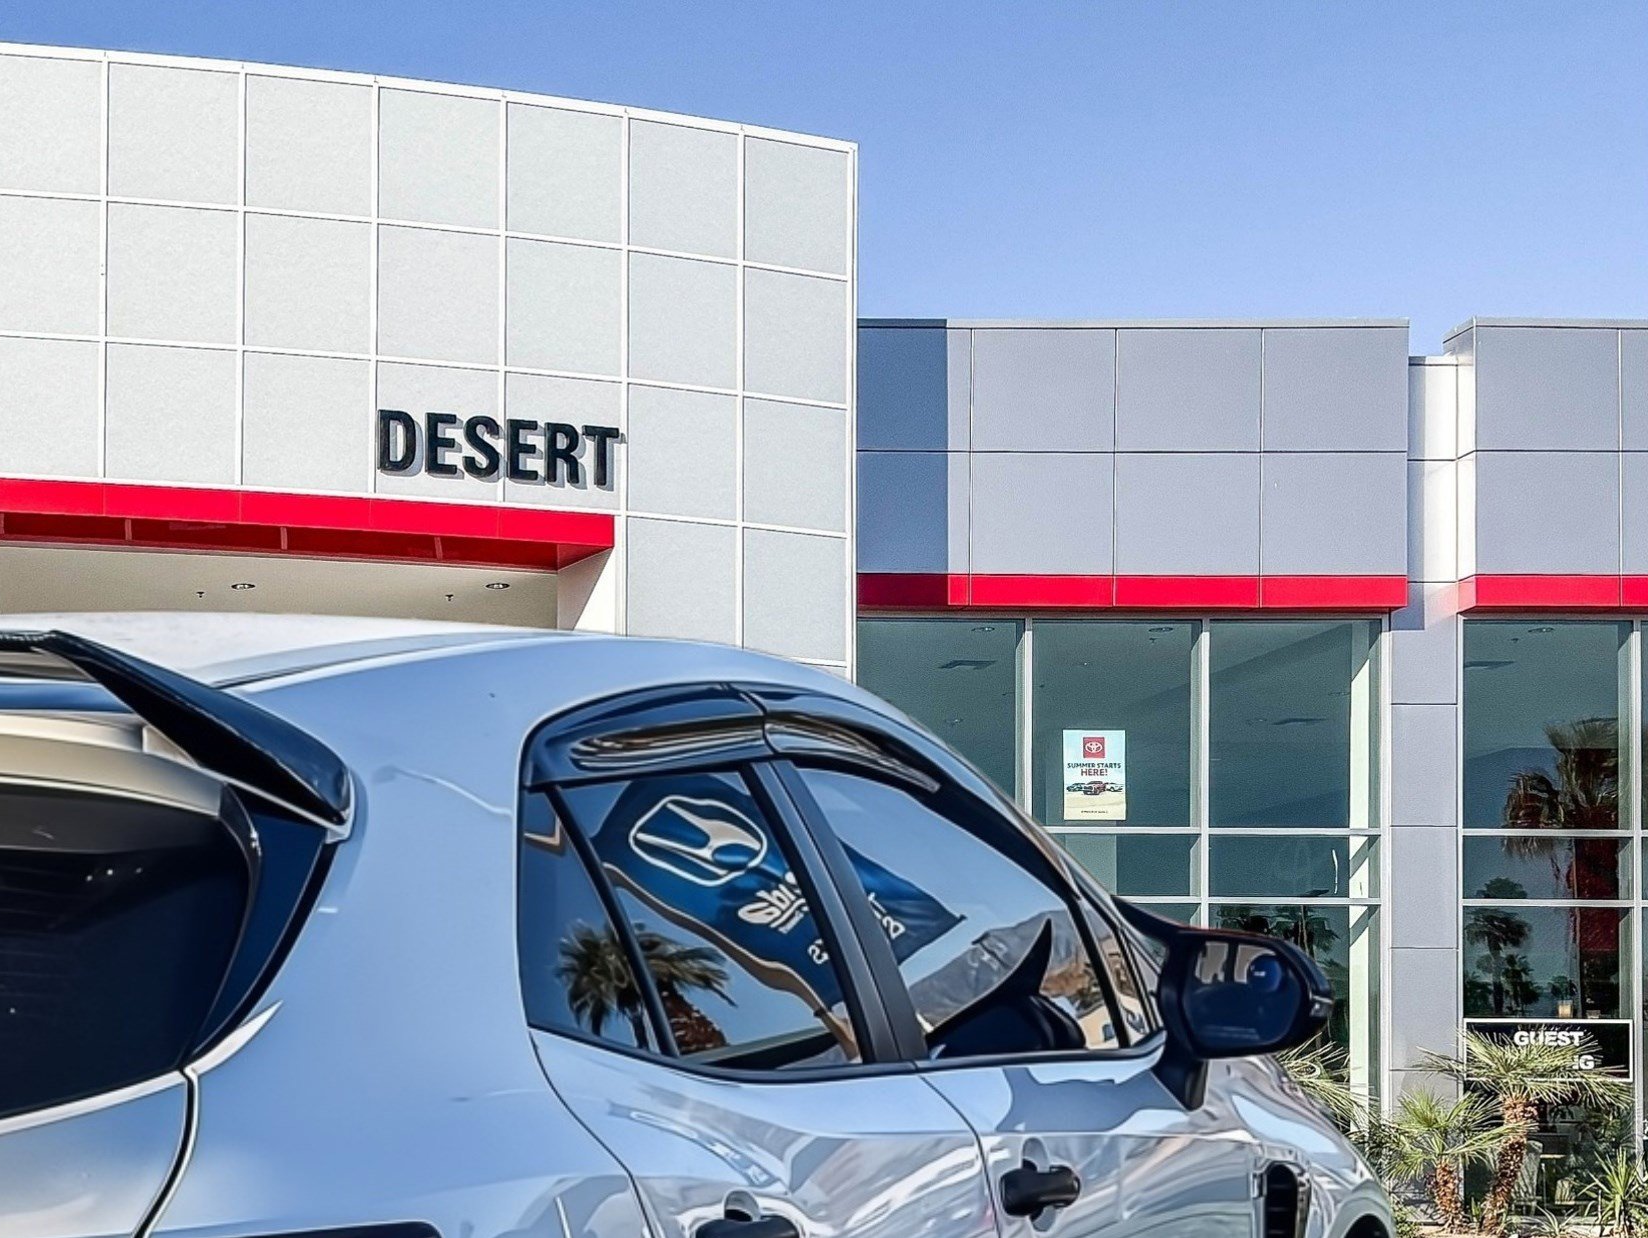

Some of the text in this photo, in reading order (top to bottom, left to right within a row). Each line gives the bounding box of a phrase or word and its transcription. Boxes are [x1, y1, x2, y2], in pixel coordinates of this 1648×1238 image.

[377, 409, 620, 486] DESERT
[1080, 768, 1108, 777] HERE!
[1513, 1030, 1584, 1047] GUEST
